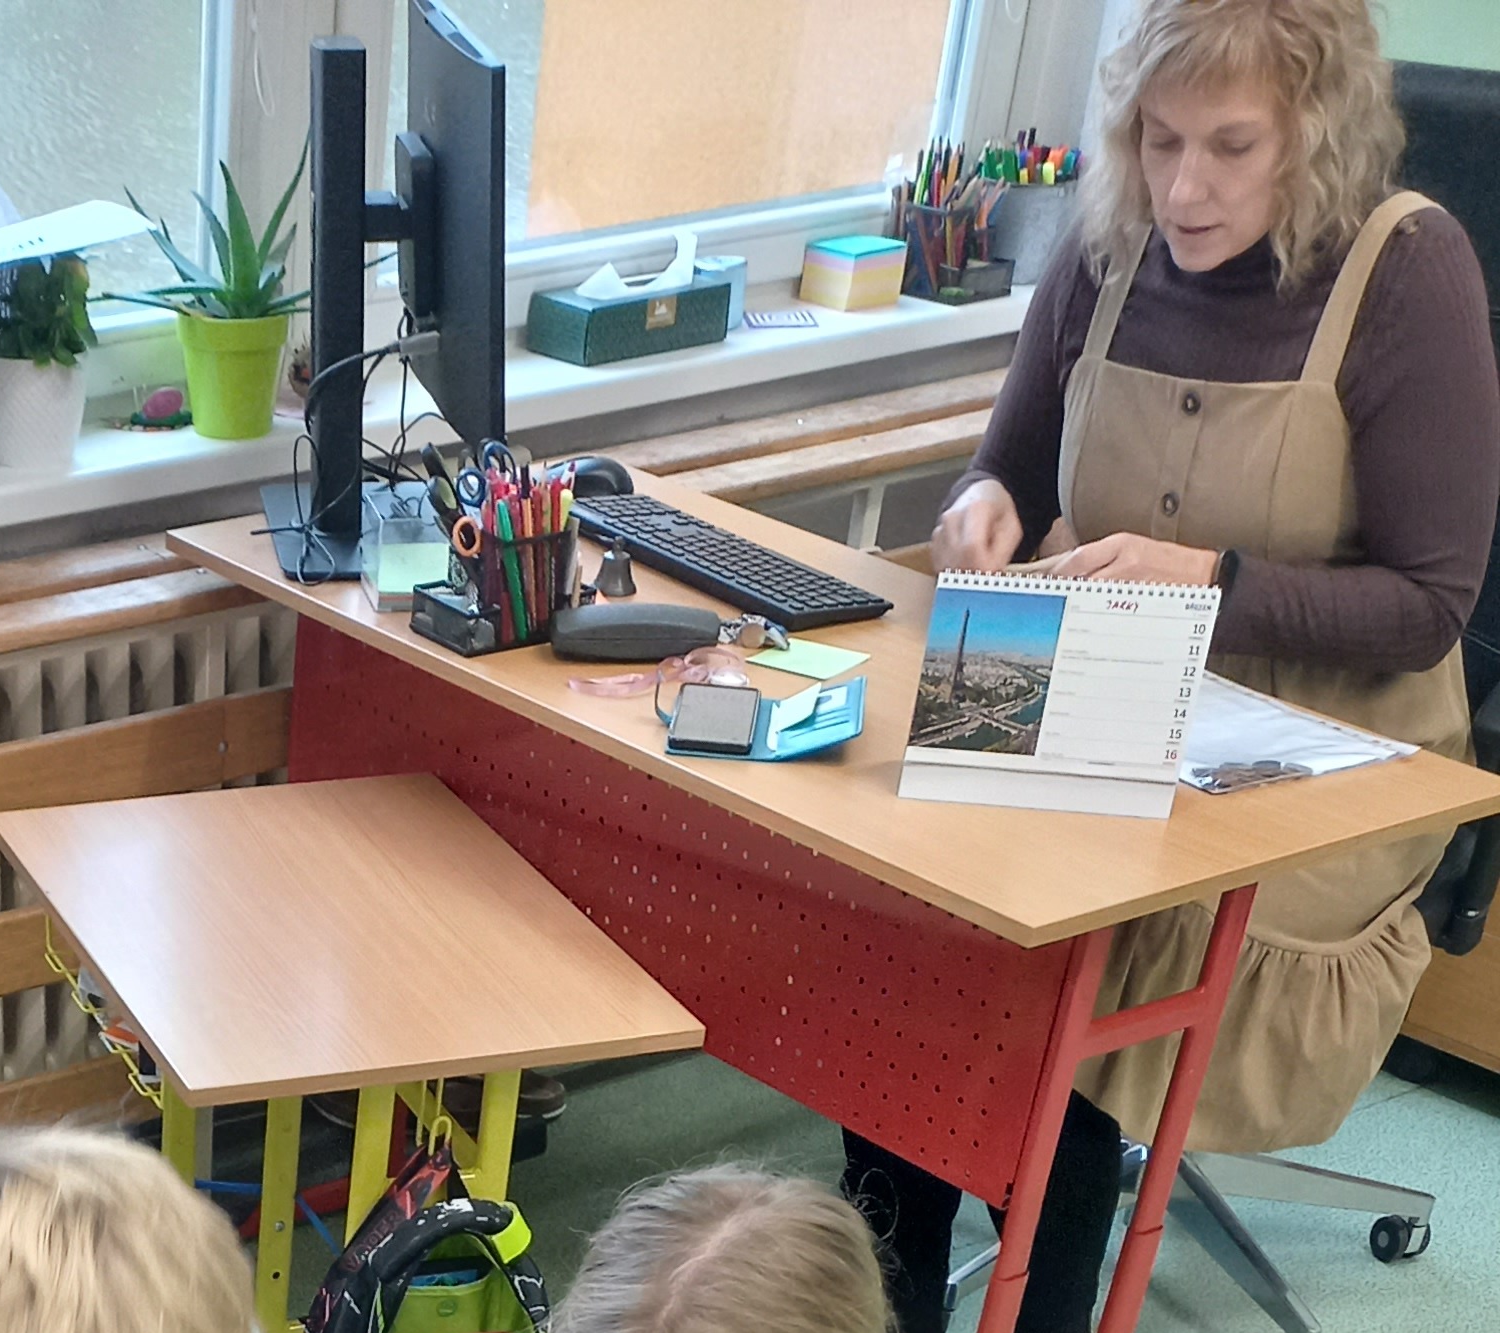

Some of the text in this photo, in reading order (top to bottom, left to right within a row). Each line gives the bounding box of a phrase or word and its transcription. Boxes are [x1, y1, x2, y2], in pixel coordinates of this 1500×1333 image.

[1192, 623, 1206, 635] 10
[1188, 644, 1200, 656] 11
[1182, 666, 1196, 677] 12
[1178, 687, 1192, 698] 13
[1173, 708, 1187, 719] 14
[1168, 728, 1182, 739] 15
[1164, 749, 1178, 760] 16
